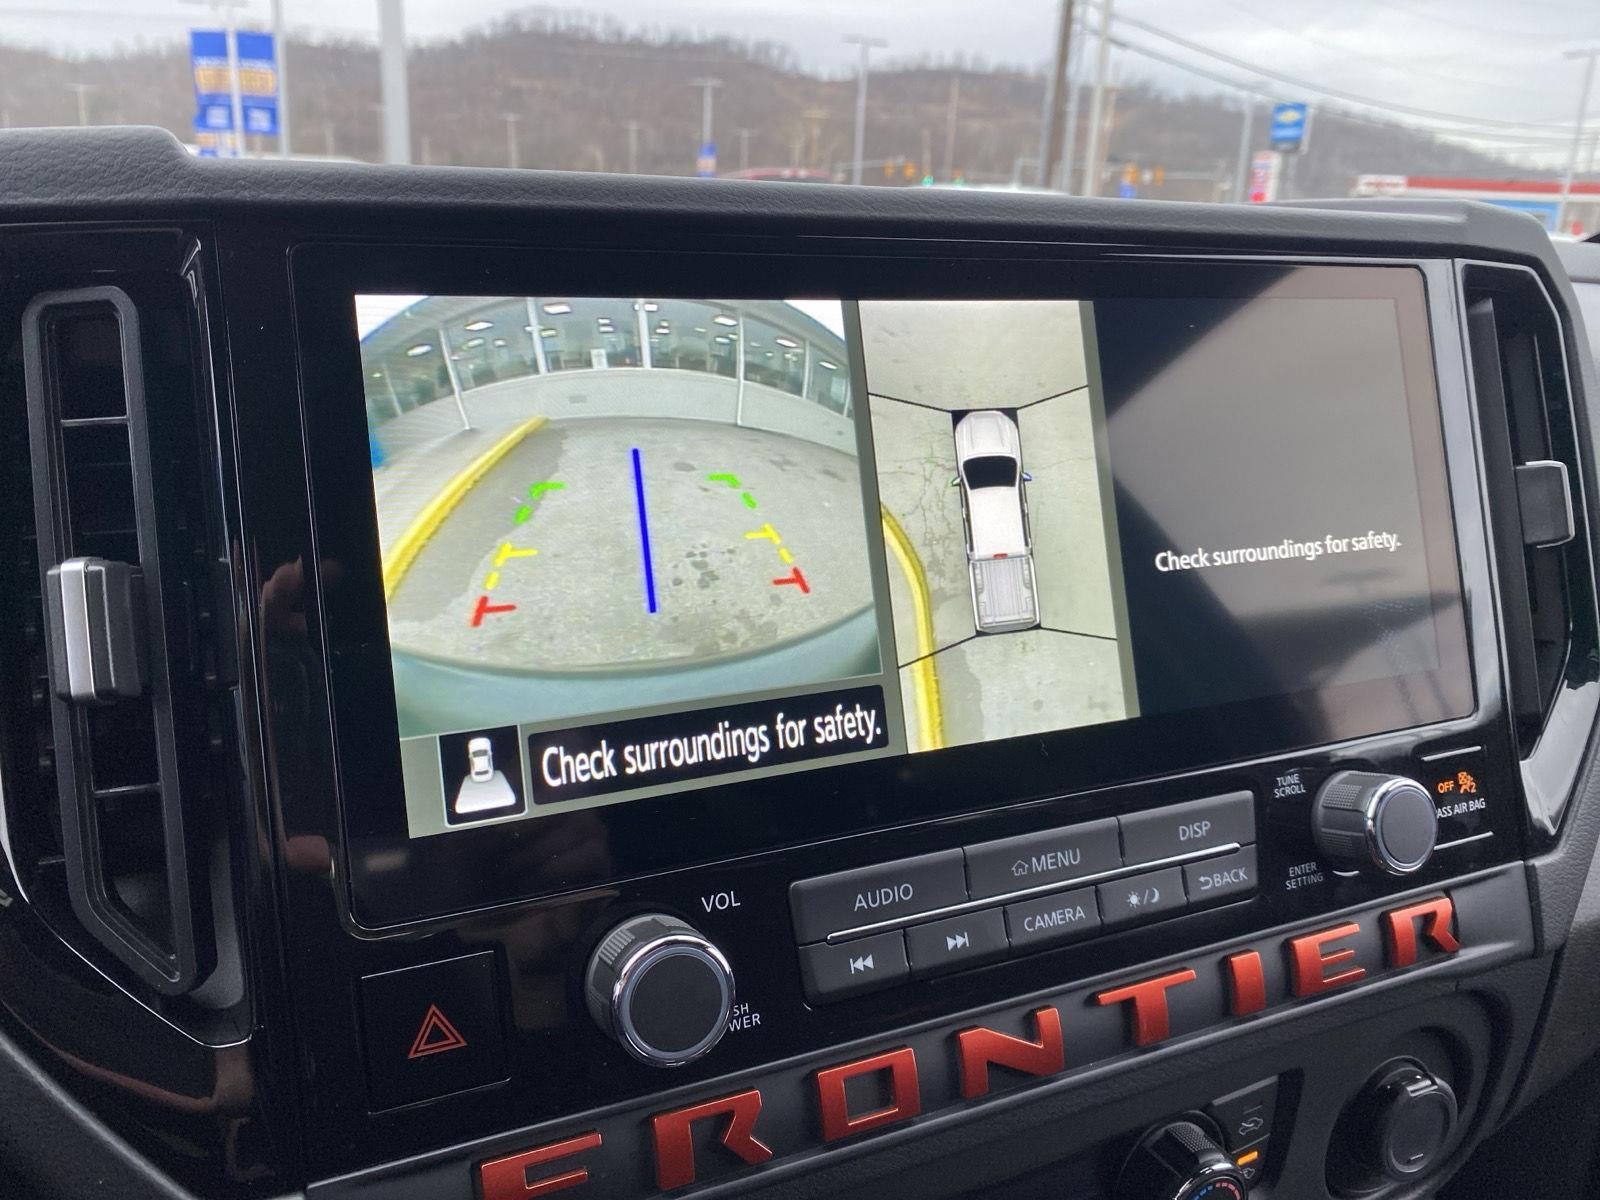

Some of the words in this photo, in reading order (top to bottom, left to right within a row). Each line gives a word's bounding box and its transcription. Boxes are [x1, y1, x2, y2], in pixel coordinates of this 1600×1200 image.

[1154, 548, 1211, 572] Check
[1213, 539, 1323, 566] surroundings
[1324, 535, 1349, 554] for
[1351, 530, 1402, 552] safety.
[541, 740, 617, 788] Check
[623, 721, 770, 775] surroundings
[775, 712, 807, 750] for
[813, 703, 882, 745] safety.
[1276, 773, 1300, 786] TUNE
[1438, 780, 1455, 793] OFF
[1274, 784, 1306, 798] SCROLL
[1435, 805, 1453, 819] ASS
[1454, 802, 1468, 815] AIR
[1469, 797, 1486, 811] BAG
[1178, 821, 1211, 841] DISP
[1031, 848, 1081, 873] MENU
[1288, 862, 1318, 877] ENTER
[1214, 867, 1248, 888] BACK
[1285, 872, 1324, 890] SETTING
[701, 890, 741, 913] VOL
[853, 883, 914, 911] AUDIO
[1023, 905, 1086, 933] CAMERA
[733, 1002, 749, 1017] SH
[729, 1013, 761, 1032] WER
[481, 897, 1462, 1200] FRONTIER
